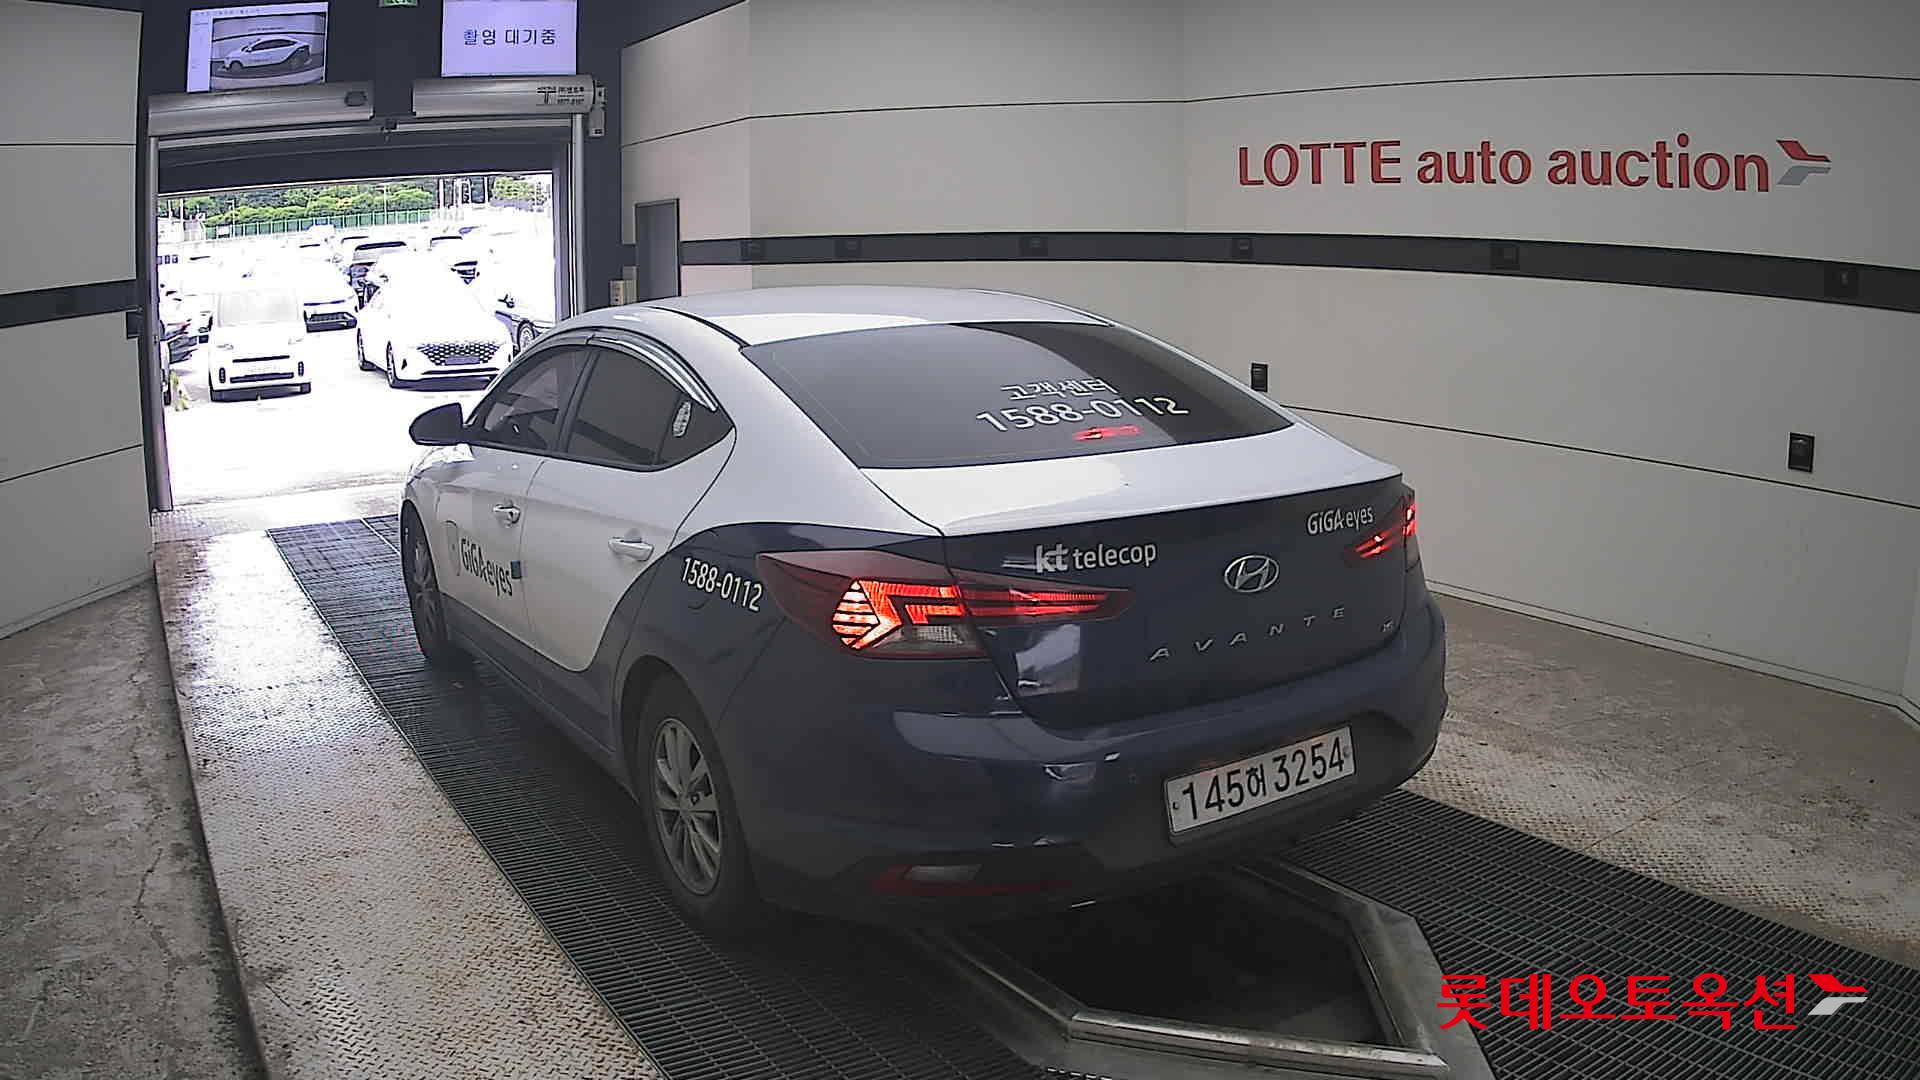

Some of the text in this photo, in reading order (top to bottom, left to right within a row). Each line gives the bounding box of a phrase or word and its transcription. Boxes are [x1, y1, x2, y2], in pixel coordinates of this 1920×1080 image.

[504, 28, 556, 46] 대기중
[1239, 133, 1769, 192] LOTTE auto auction
[1001, 378, 1119, 400] 고객센터
[976, 396, 1189, 432] 1588-0112
[1035, 542, 1157, 573] kt telecop
[681, 556, 763, 612] 1588-0112
[1150, 606, 1346, 662] AVANTE
[1182, 736, 1345, 820] 145허 3254
